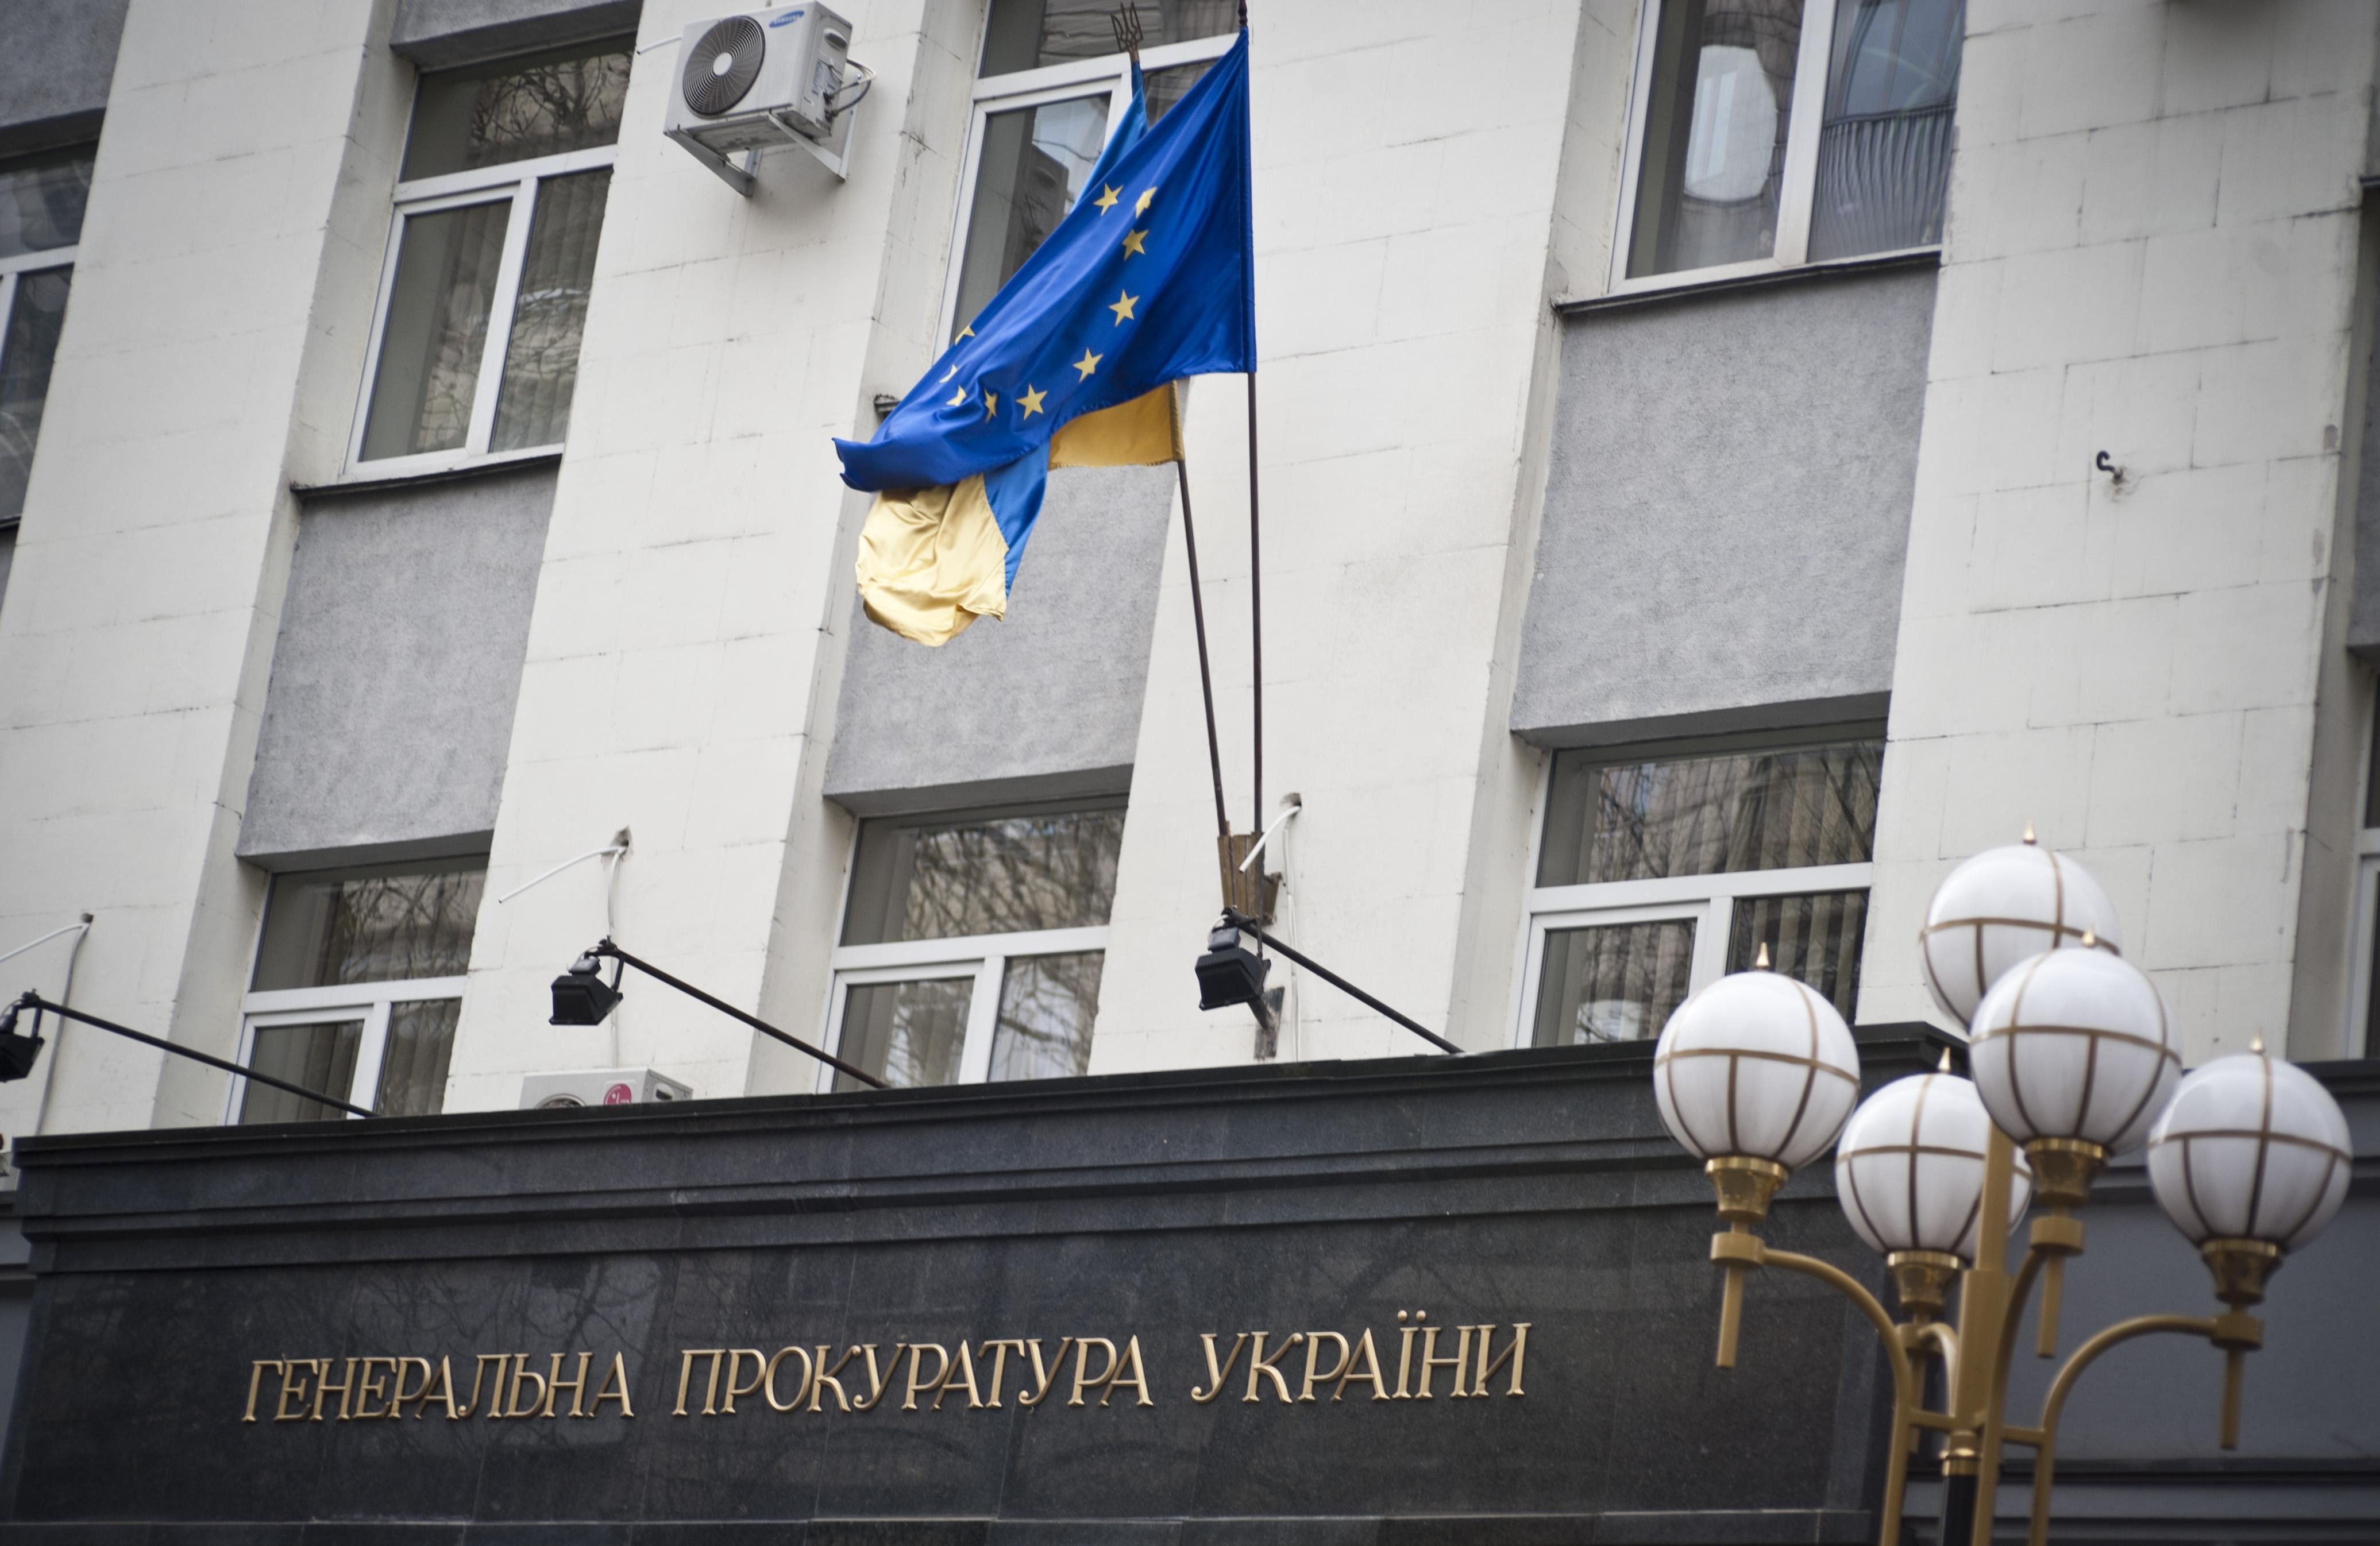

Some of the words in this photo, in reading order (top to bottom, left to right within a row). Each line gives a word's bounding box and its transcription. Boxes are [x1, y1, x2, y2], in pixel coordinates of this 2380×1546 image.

[241, 1351, 634, 1423] ГЕНЕРАЛЬНА
[671, 1334, 1154, 1416] ПРОКУРАТУРА
[1191, 1309, 1532, 1404] УКРАЇНИ
